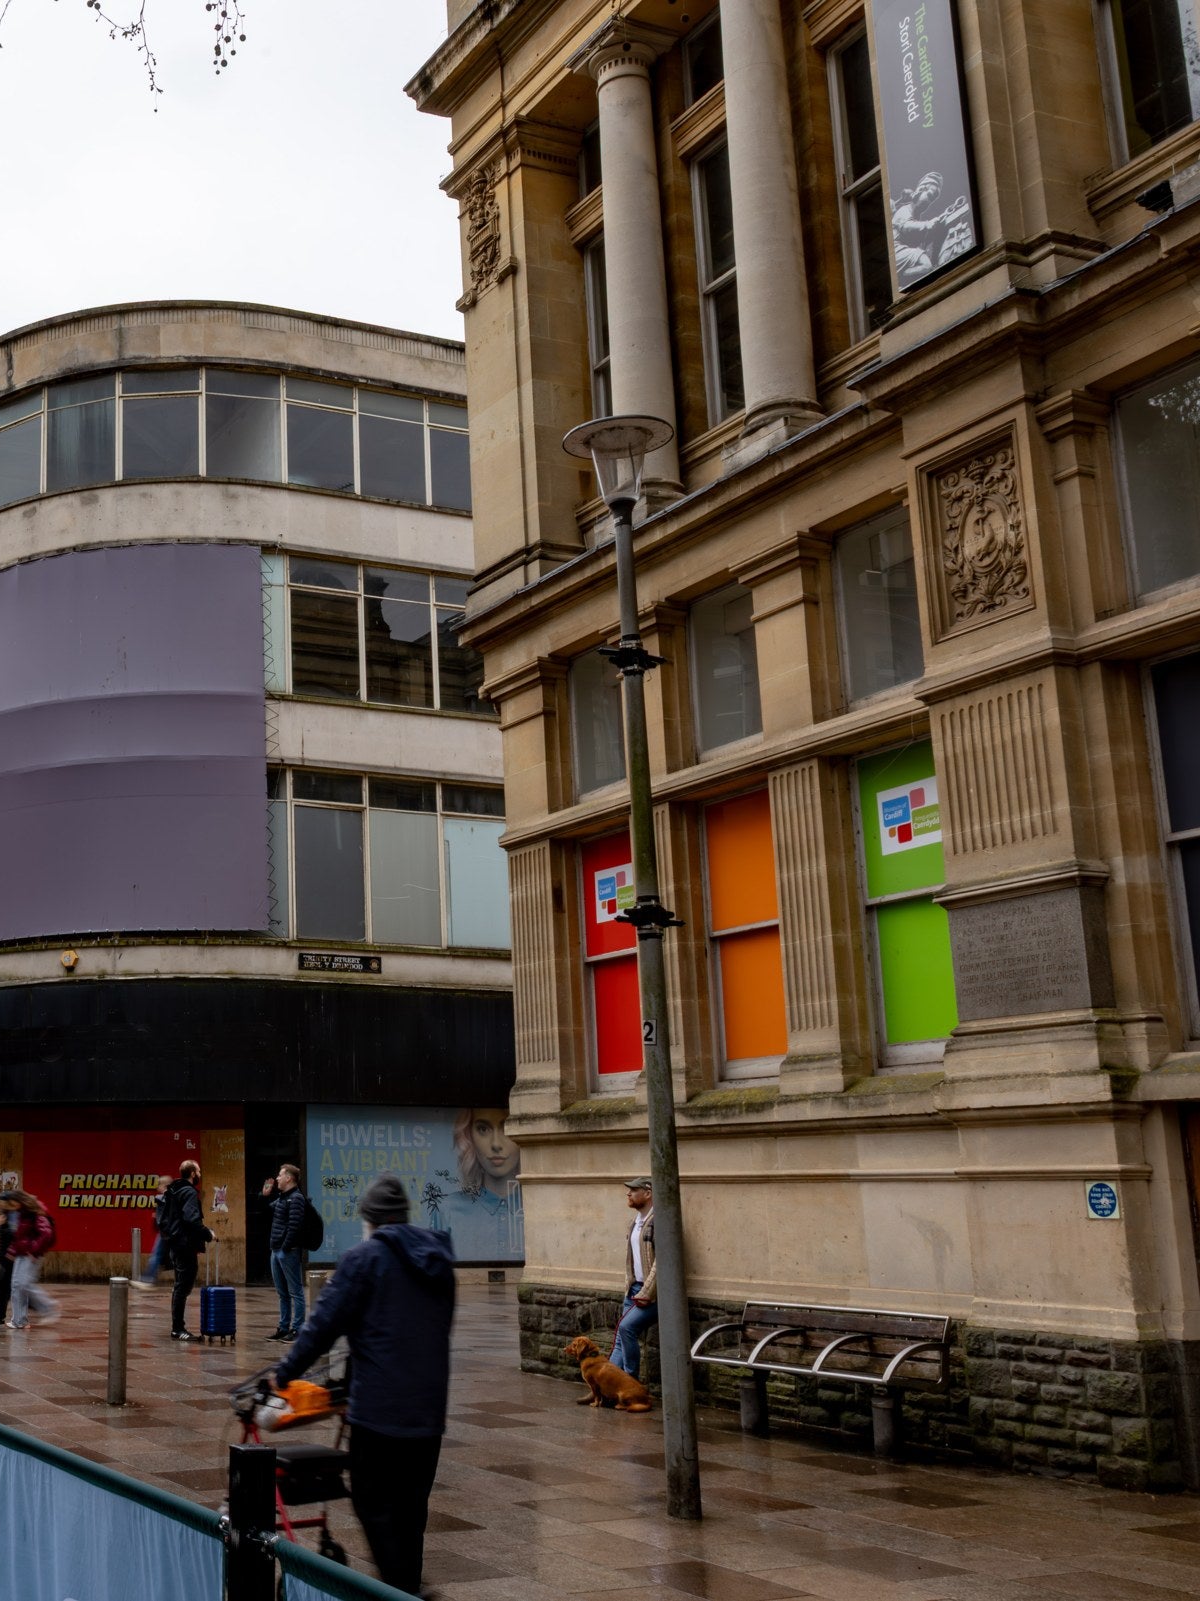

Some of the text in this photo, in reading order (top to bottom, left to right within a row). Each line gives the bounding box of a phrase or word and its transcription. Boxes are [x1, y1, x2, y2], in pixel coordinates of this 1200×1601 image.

[899, 16, 920, 123] Stori Caerdydd
[914, 3, 934, 128] The Cardiff Story
[884, 809, 903, 821] Cardiff
[643, 1022, 653, 1041] 2
[319, 1123, 432, 1147] HOWELLS:
[320, 1149, 431, 1173] A VIBRANT
[59, 1174, 160, 1189] PRICHARD
